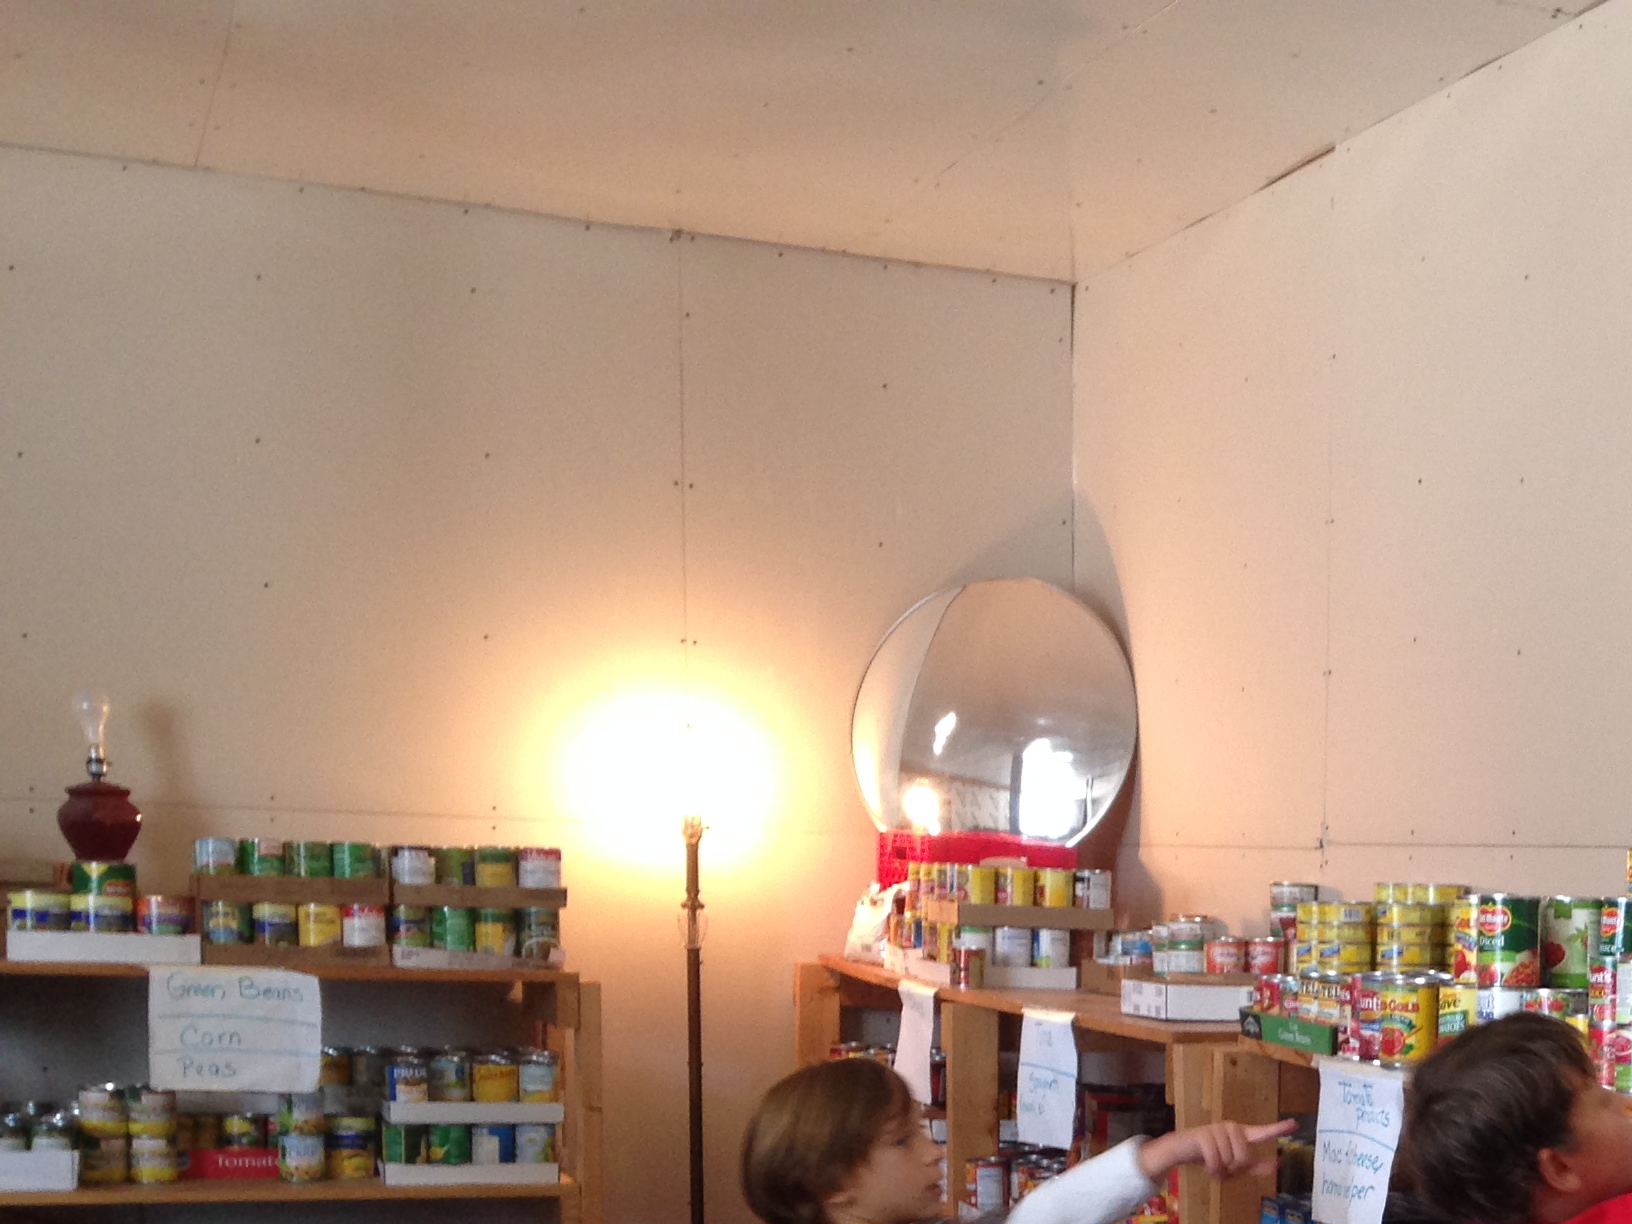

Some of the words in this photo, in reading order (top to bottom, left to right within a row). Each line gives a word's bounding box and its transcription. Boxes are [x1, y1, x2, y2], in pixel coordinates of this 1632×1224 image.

[167, 970, 225, 1000] Green
[238, 975, 303, 1002] Beans
[180, 1023, 241, 1046] Corn
[177, 1054, 236, 1078] Peas
